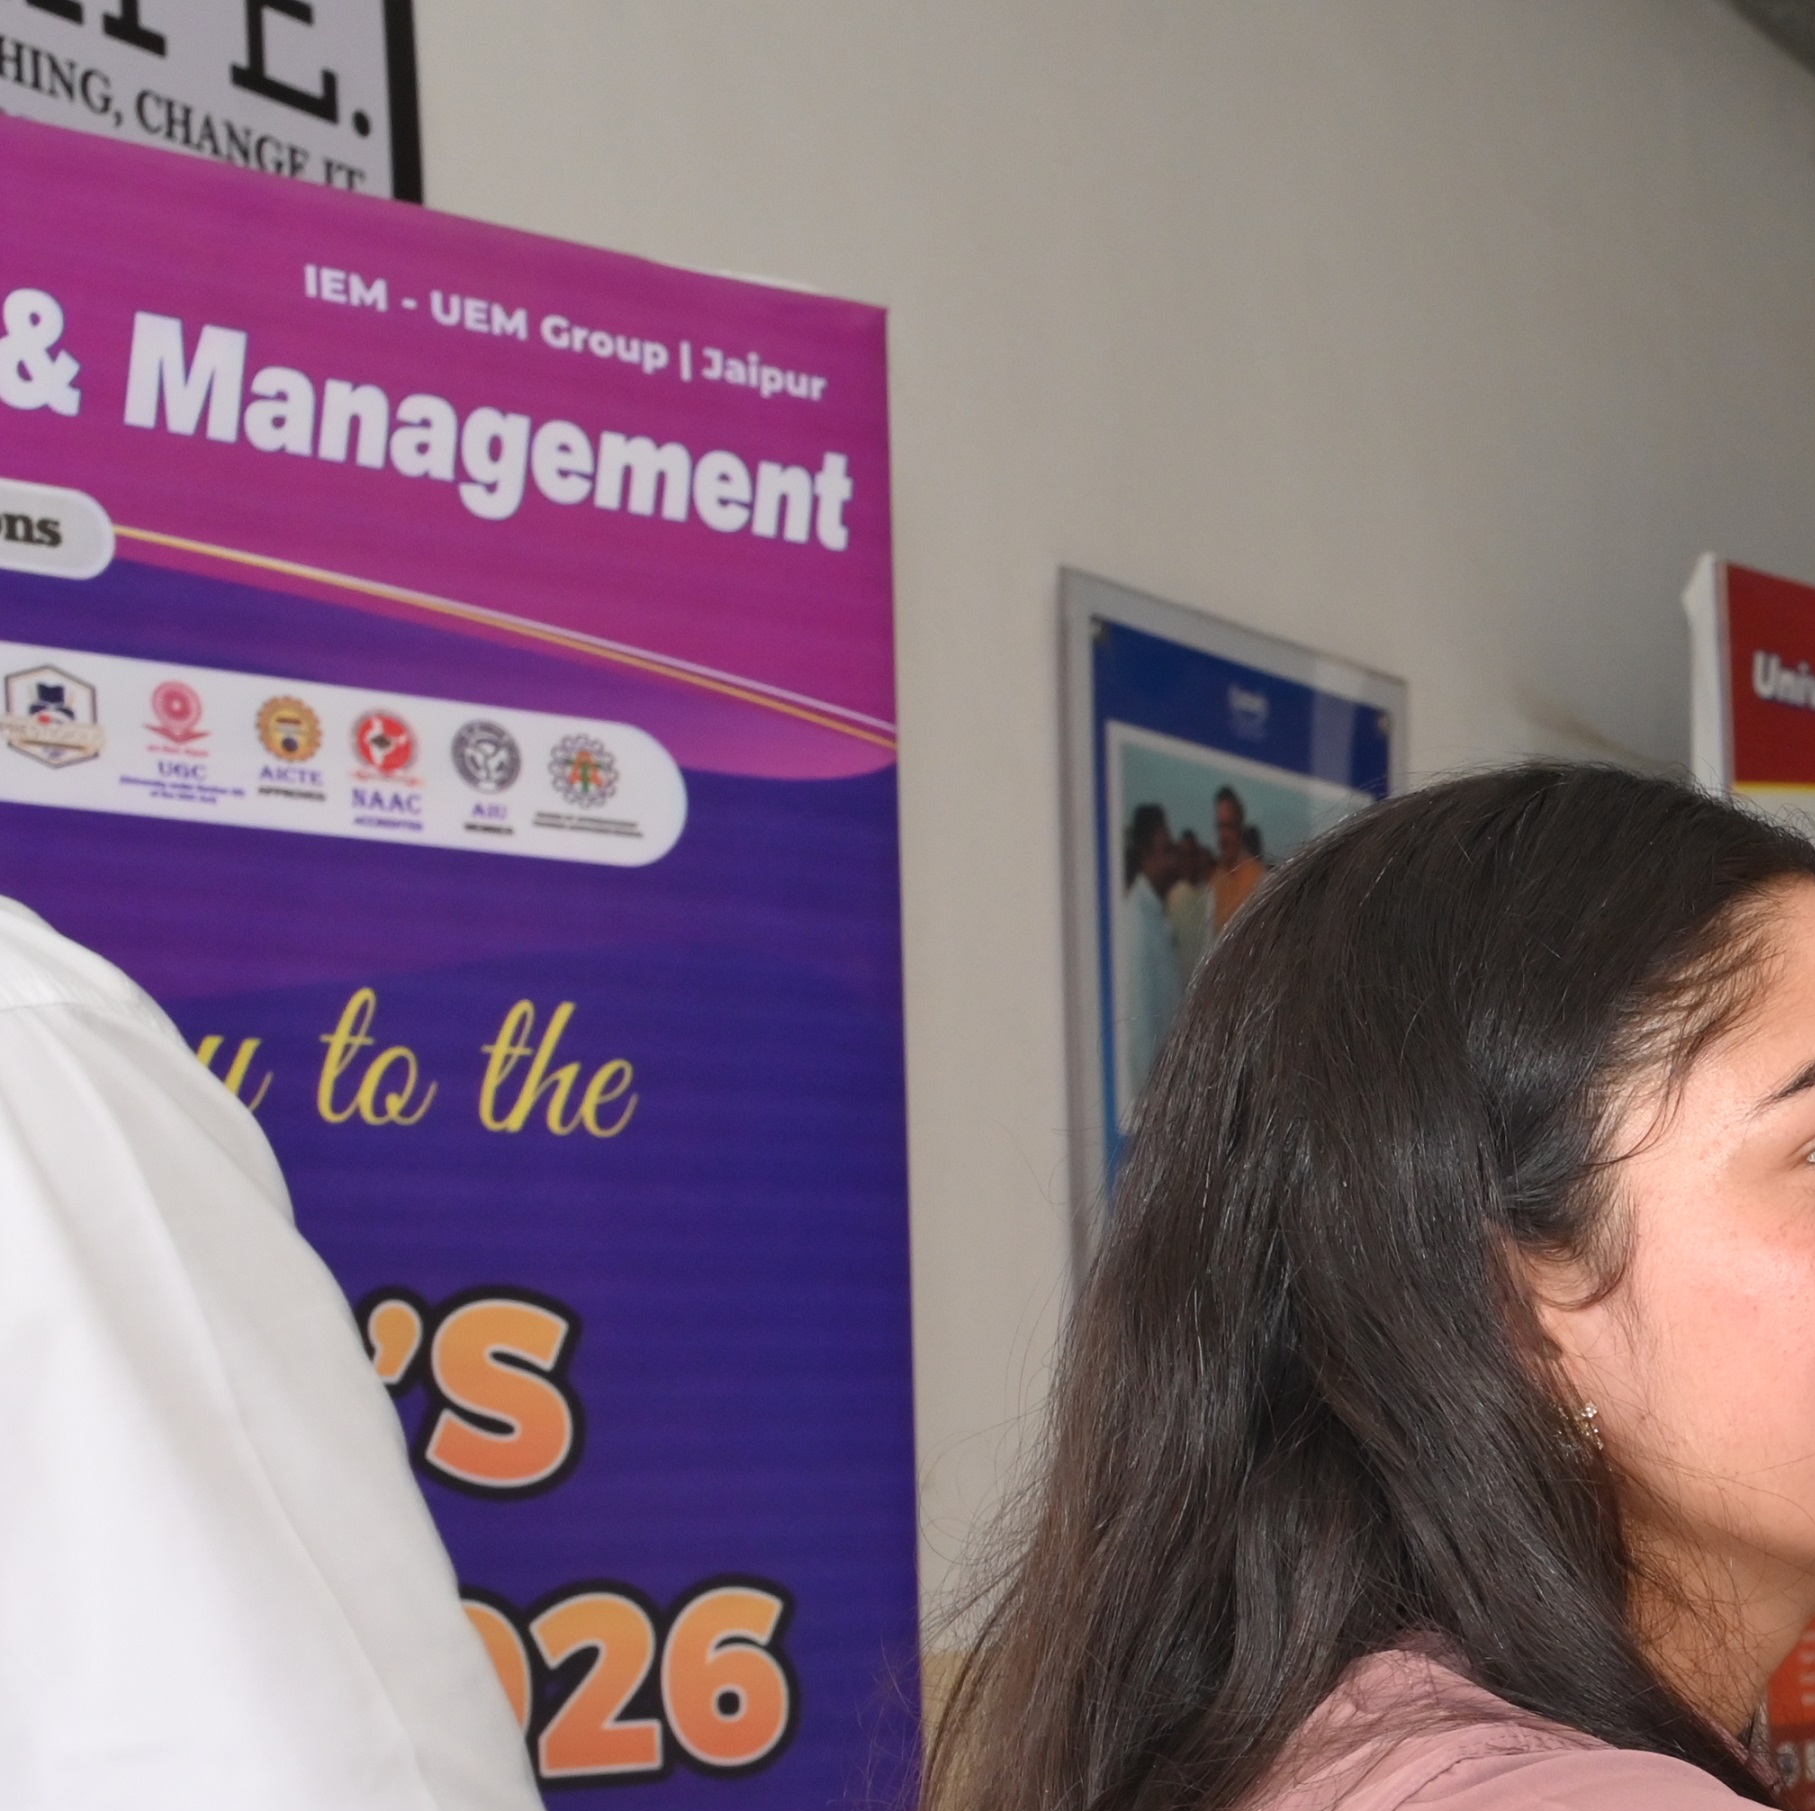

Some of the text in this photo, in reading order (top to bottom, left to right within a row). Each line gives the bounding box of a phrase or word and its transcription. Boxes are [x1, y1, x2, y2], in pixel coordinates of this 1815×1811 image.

[136, 90, 310, 180] CHANGE
[304, 264, 388, 312] IEM
[401, 299, 417, 310] -
[430, 291, 529, 341] UEM
[540, 315, 669, 374] Group
[702, 348, 827, 402] Jaipur
[0, 288, 855, 551] & Management
[0, 513, 62, 548] ns
[158, 761, 207, 782] UGC
[259, 765, 323, 786] AICTE
[352, 787, 423, 814] NAAC
[318, 988, 436, 1126] to
[477, 999, 638, 1138] the
